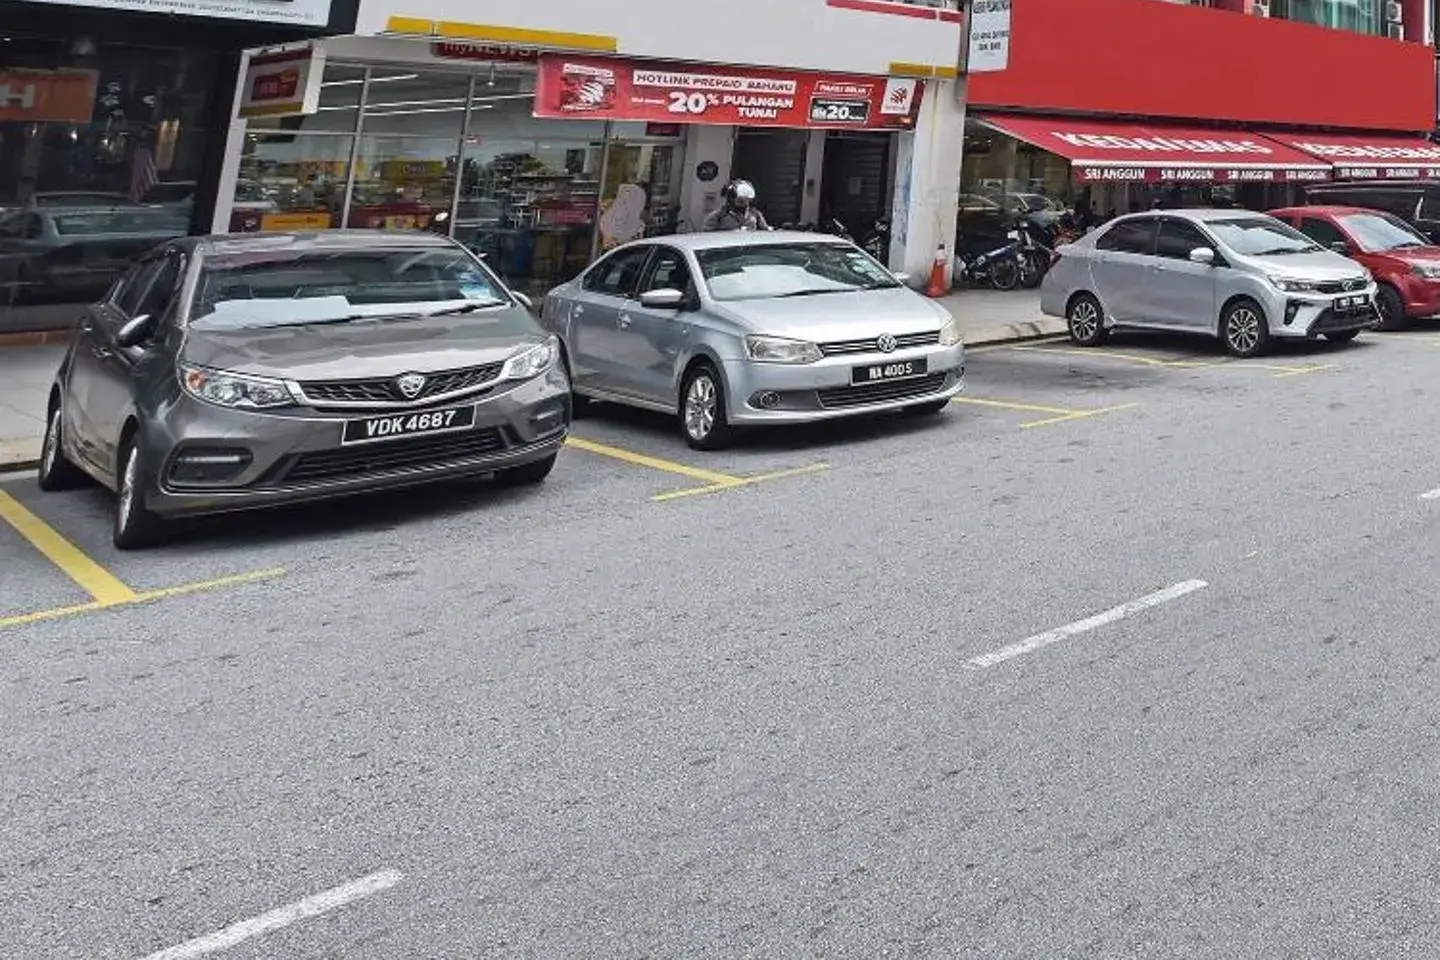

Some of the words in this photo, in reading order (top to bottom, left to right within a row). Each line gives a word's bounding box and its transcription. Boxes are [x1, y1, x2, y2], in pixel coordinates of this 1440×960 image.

[636, 73, 690, 86] HOTLINK
[692, 78, 742, 89] PREPAID
[747, 81, 794, 92] BAHARU
[667, 91, 719, 114] 20%
[723, 95, 794, 108] PULANGAN
[738, 106, 777, 118] TUNAI
[1085, 168, 1100, 179] SRI
[1101, 168, 1145, 180] ANGGUN
[1177, 169, 1215, 180] ANGGUN
[905, 362, 913, 374] S
[365, 414, 404, 437] VDK
[405, 408, 456, 435] 4687
